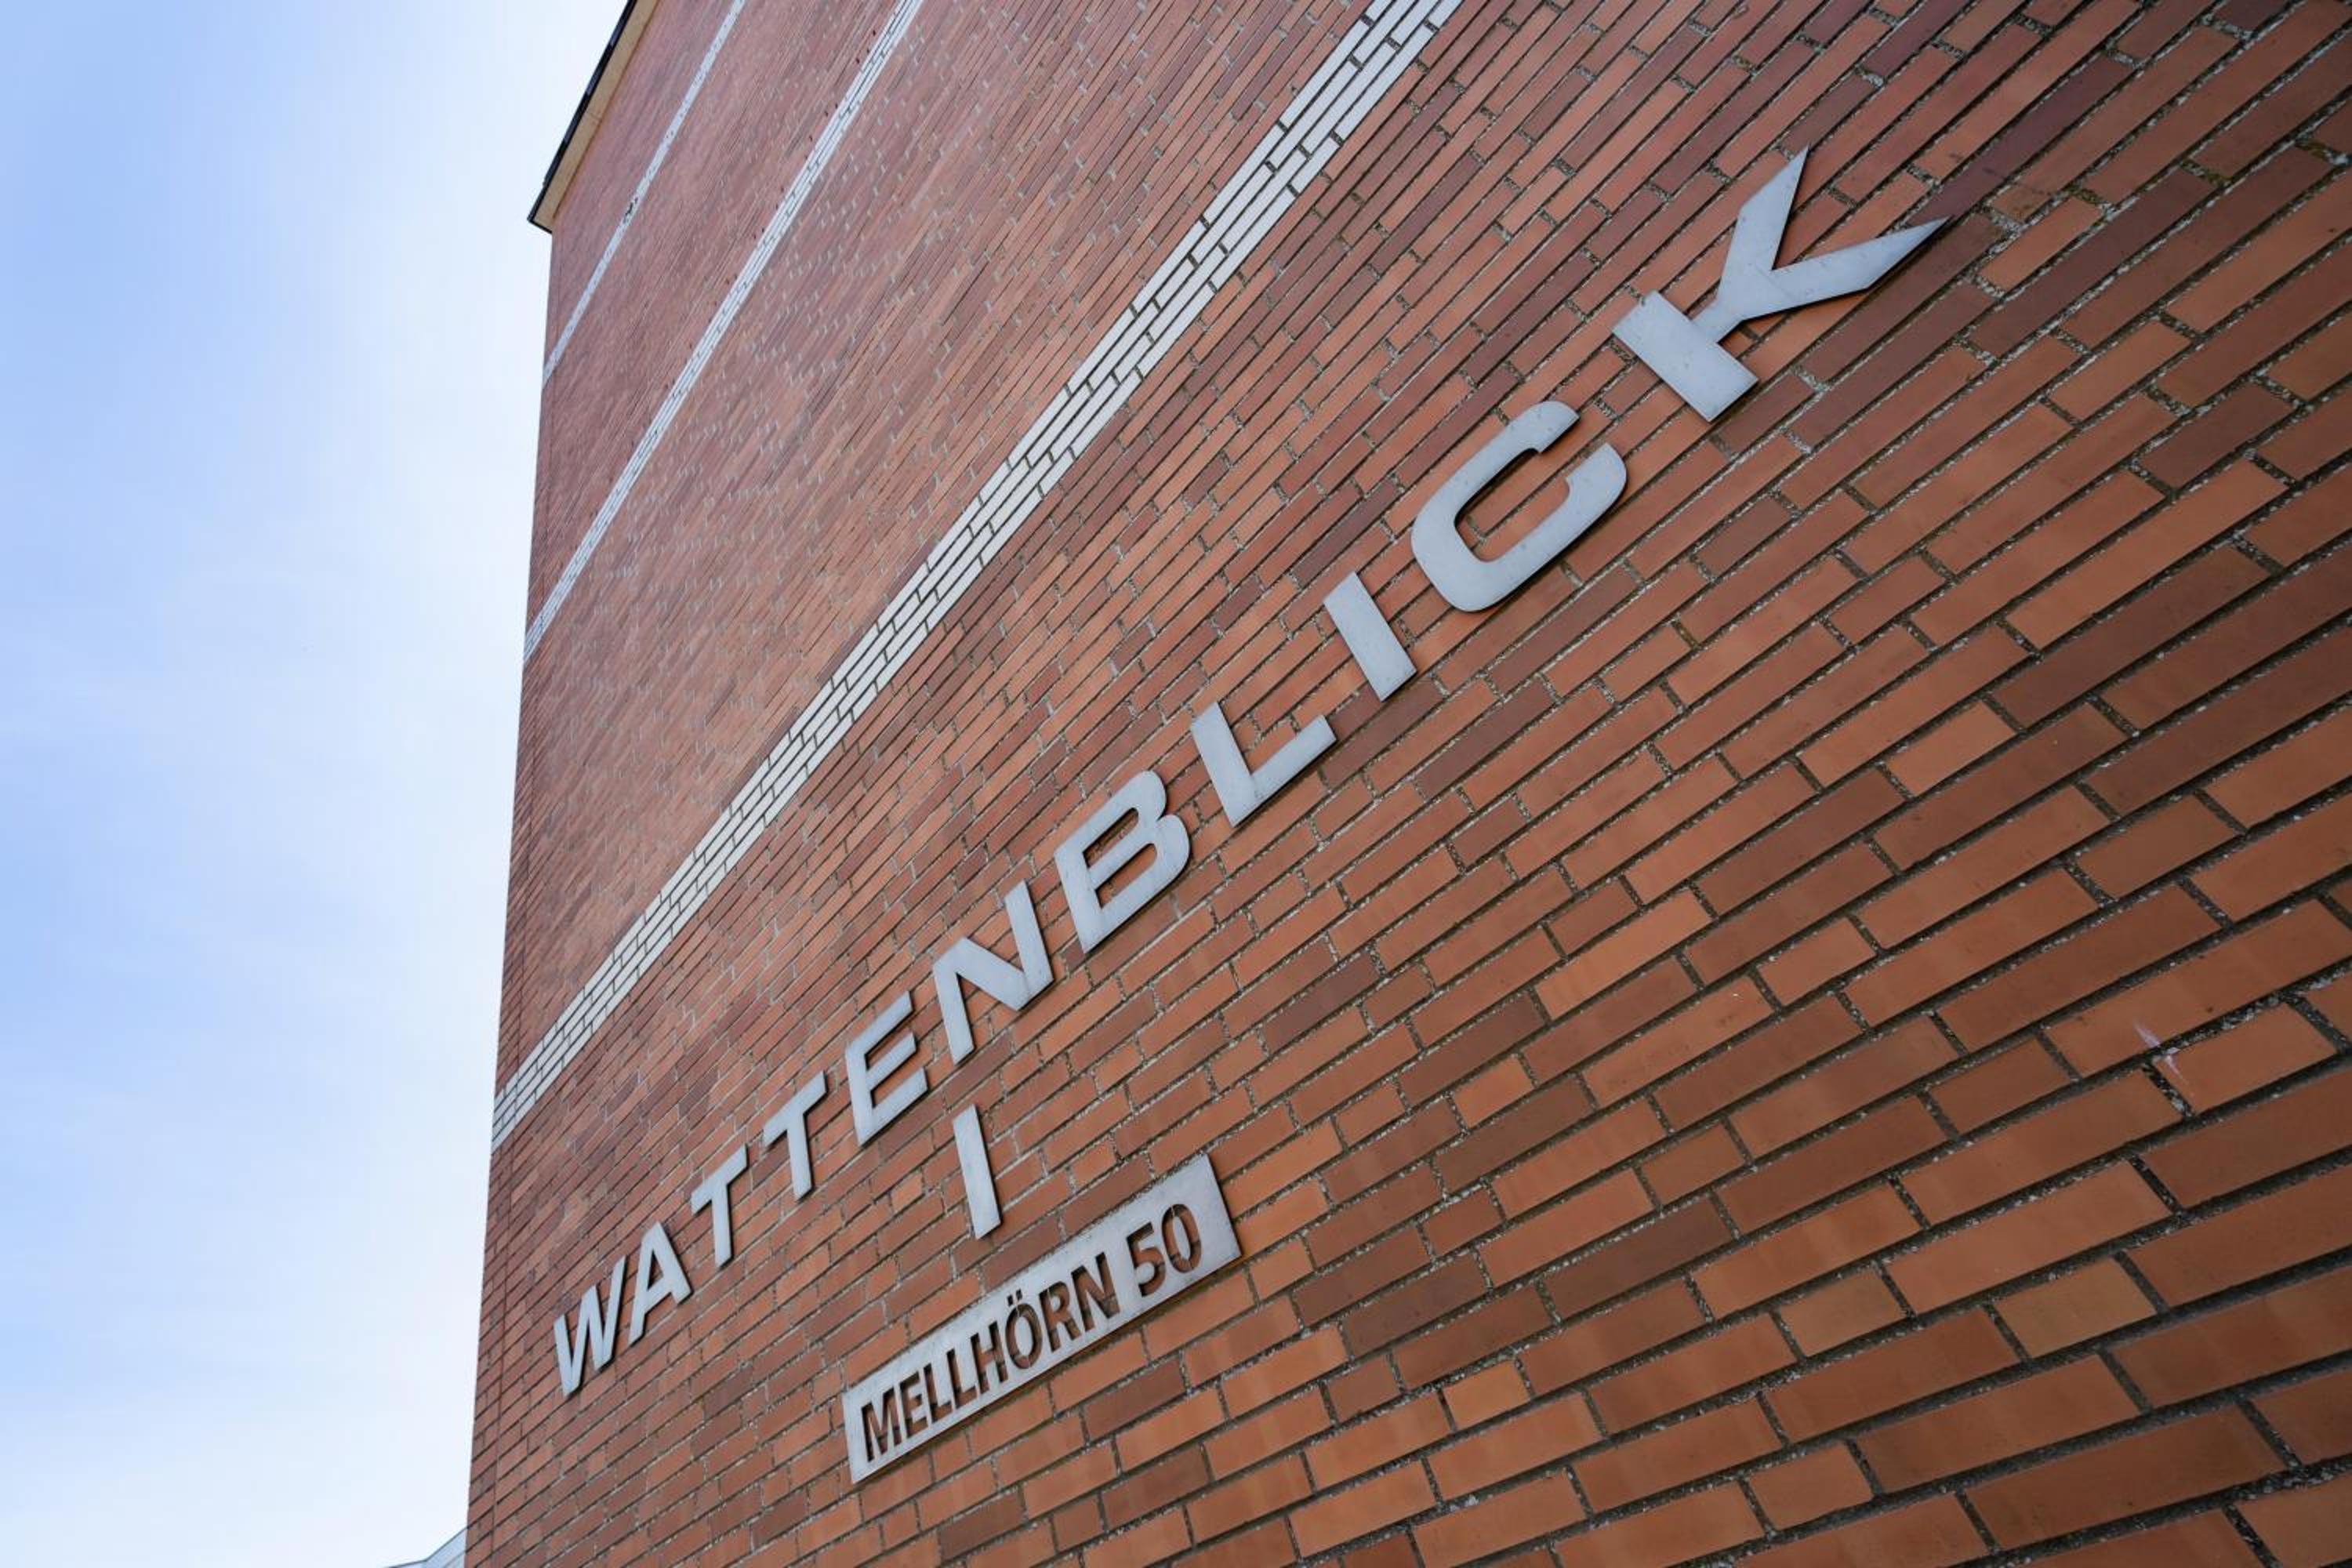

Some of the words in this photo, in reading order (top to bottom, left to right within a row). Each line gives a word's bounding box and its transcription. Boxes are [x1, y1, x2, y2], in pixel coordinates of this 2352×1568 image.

[554, 146, 1953, 1397] WATTENBLICK
[861, 1252, 1121, 1463] MELLHÖRN
[1127, 1203, 1202, 1298] 50
